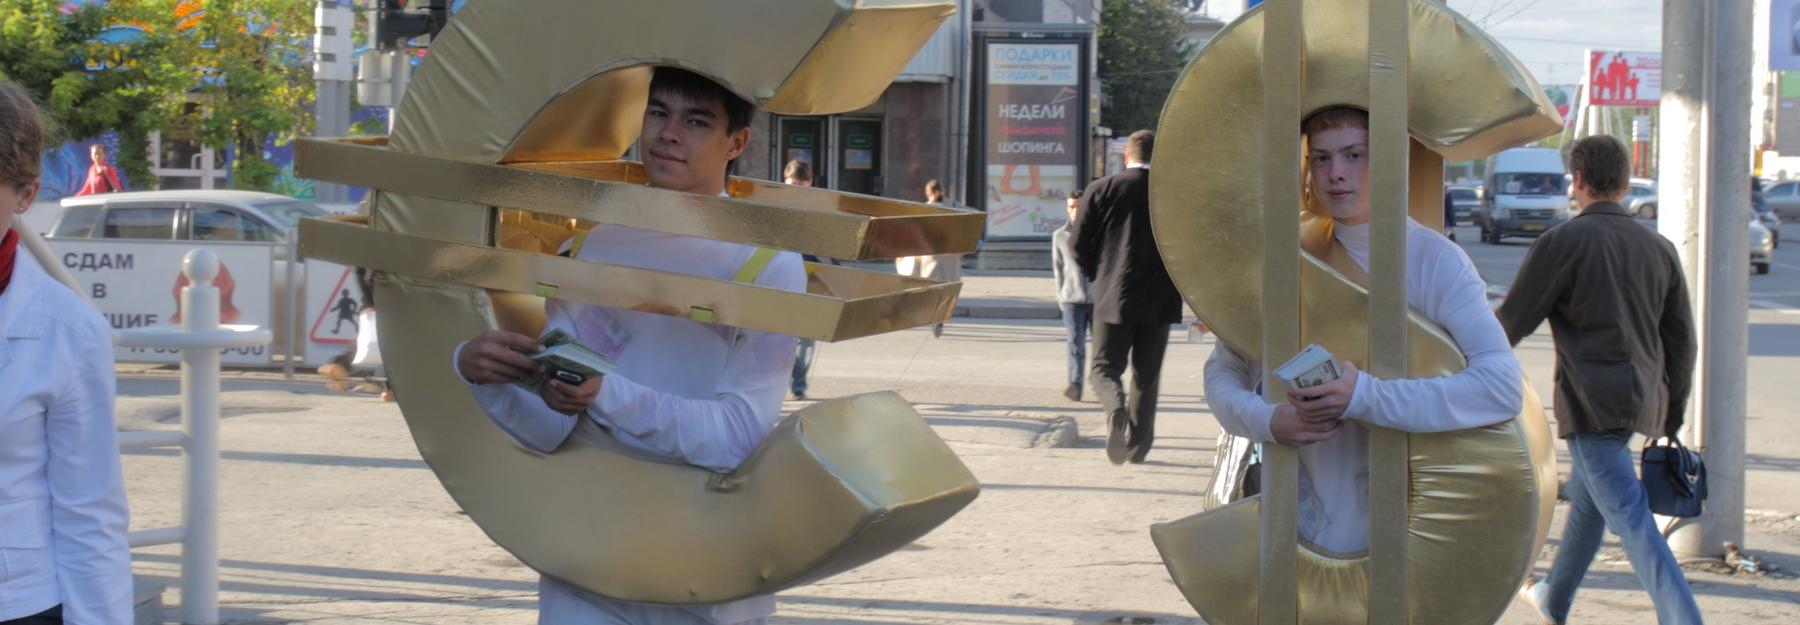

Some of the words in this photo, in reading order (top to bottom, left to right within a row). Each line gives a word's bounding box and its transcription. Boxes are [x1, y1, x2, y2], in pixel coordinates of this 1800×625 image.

[995, 48, 1072, 62] ПОДАРКИ
[998, 104, 1065, 120] НЕДЕЛИ
[998, 142, 1064, 154] ШОПИНГА
[63, 252, 133, 271] СДАМ
[92, 283, 106, 298] В
